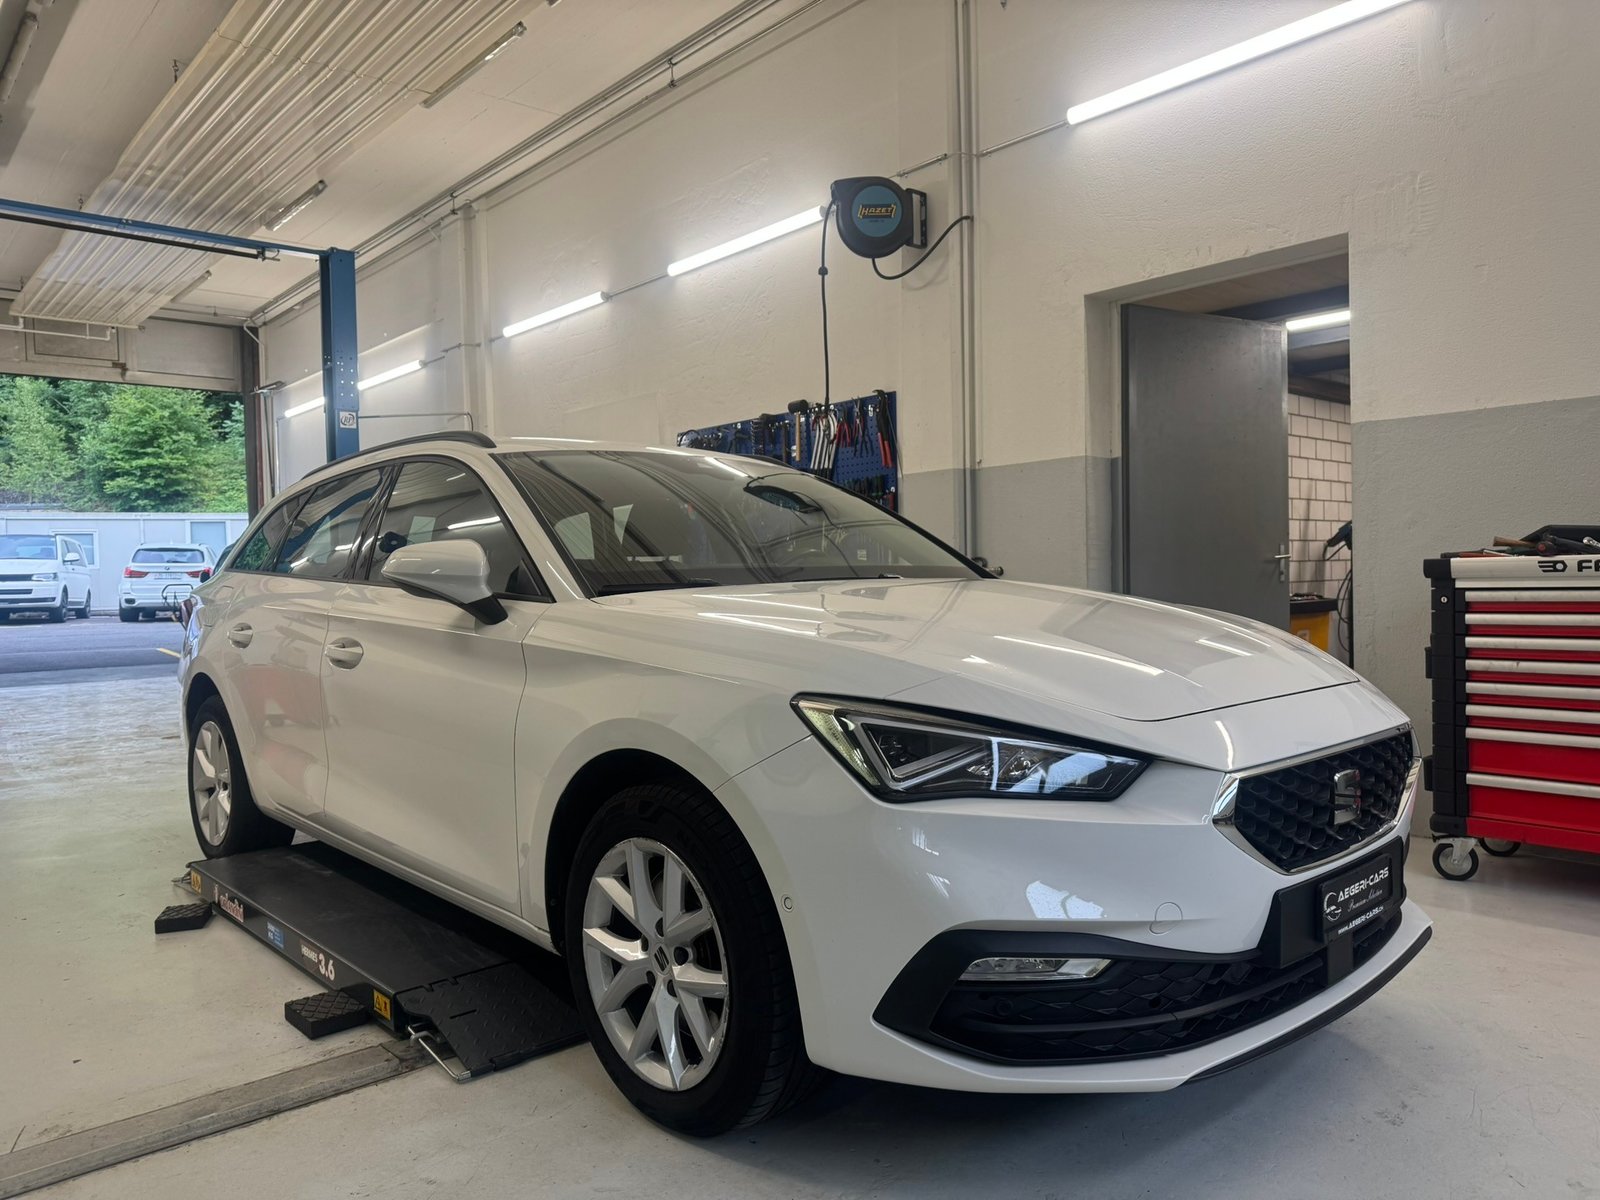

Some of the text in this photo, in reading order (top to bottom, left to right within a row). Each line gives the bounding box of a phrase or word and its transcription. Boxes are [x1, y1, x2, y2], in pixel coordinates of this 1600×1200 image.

[861, 207, 893, 216] HAZET
[1337, 866, 1389, 902] AEGERI-CARS
[318, 953, 335, 981] 3.6
